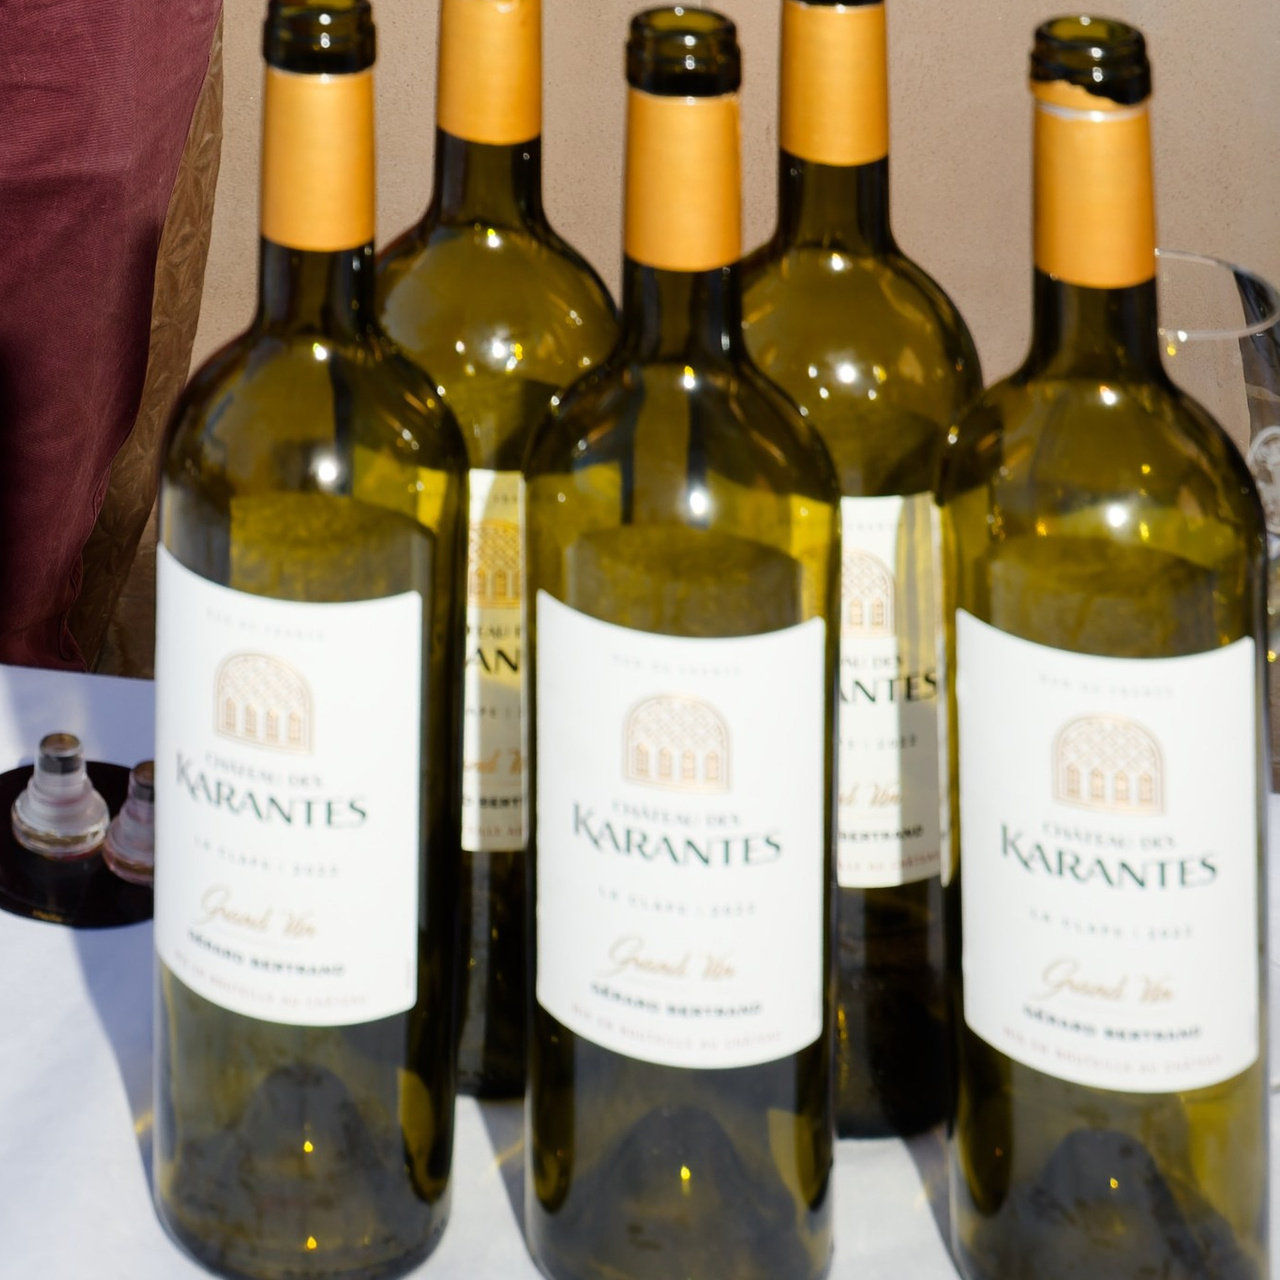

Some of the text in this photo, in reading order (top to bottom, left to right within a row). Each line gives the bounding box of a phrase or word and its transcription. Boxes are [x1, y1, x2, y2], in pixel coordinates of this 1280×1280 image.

[176, 748, 369, 830] KARANTES
[571, 798, 784, 870] KARANTES
[999, 819, 1220, 891] KARANTES
